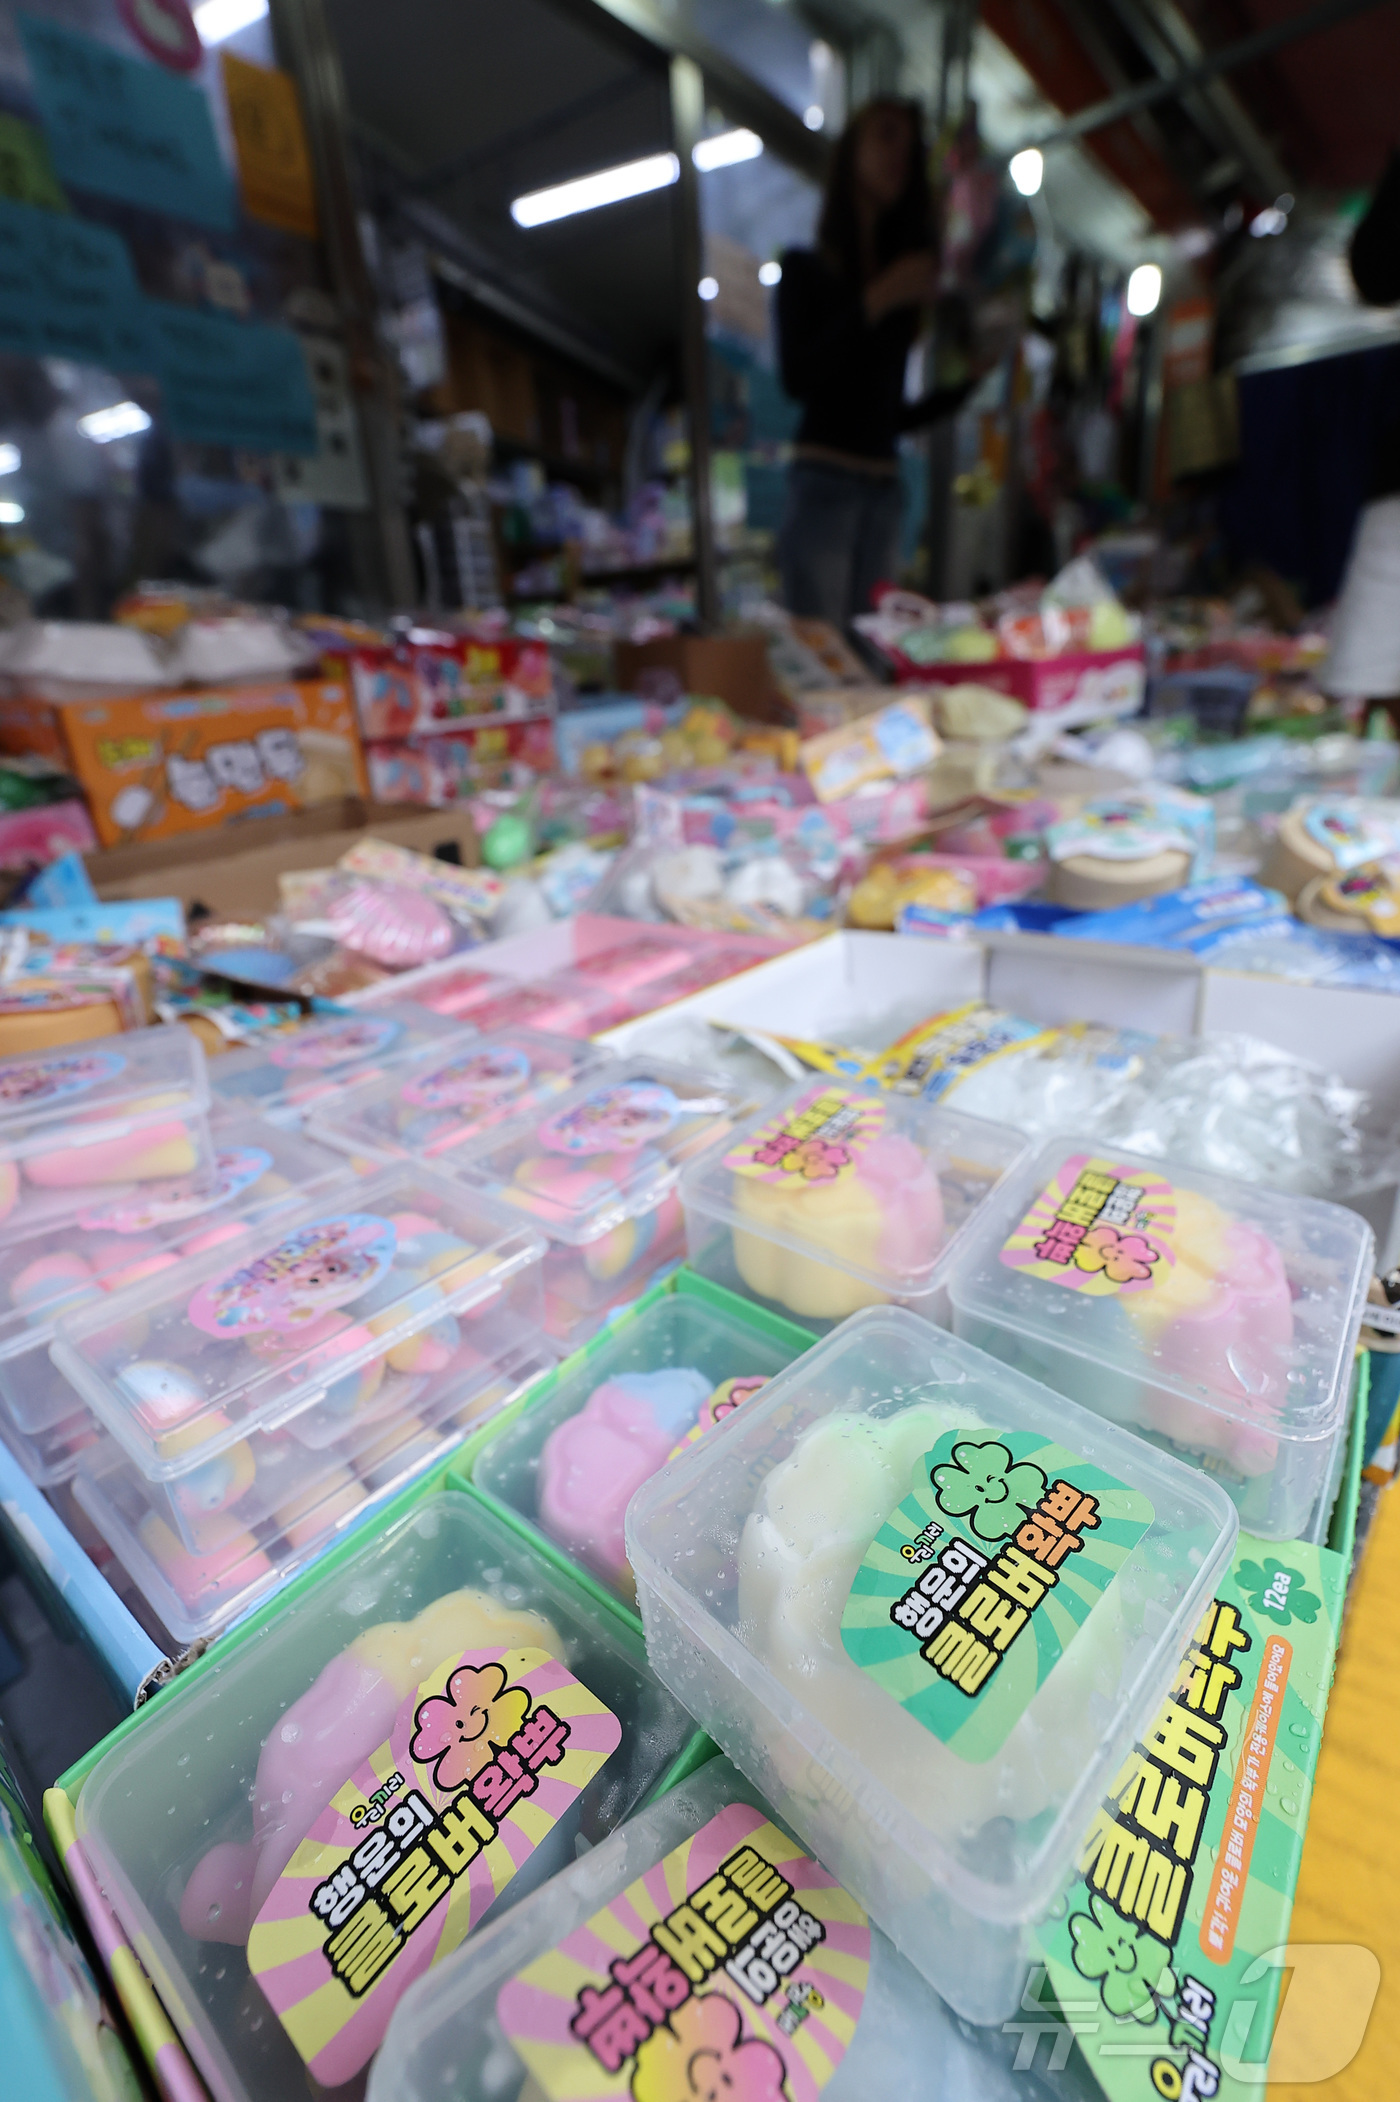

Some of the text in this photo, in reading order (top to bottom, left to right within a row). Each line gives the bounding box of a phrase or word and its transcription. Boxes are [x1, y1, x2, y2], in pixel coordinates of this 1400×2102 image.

[900, 1521, 944, 1564] 우리끼리
[892, 1538, 990, 1640] 행운의
[1262, 1571, 1292, 1611] 12ea
[1263, 1643, 1285, 1693] 들어있어요
[1249, 1690, 1274, 1756] 전용케이스에
[349, 1771, 405, 1829] 우리끼리
[1233, 1789, 1253, 1832] 모양의
[311, 1791, 436, 1929] 행운의
[1224, 1828, 1244, 1872] 클로버
[1215, 1868, 1239, 1912] 귀여운
[723, 1899, 825, 2006] 행운의
